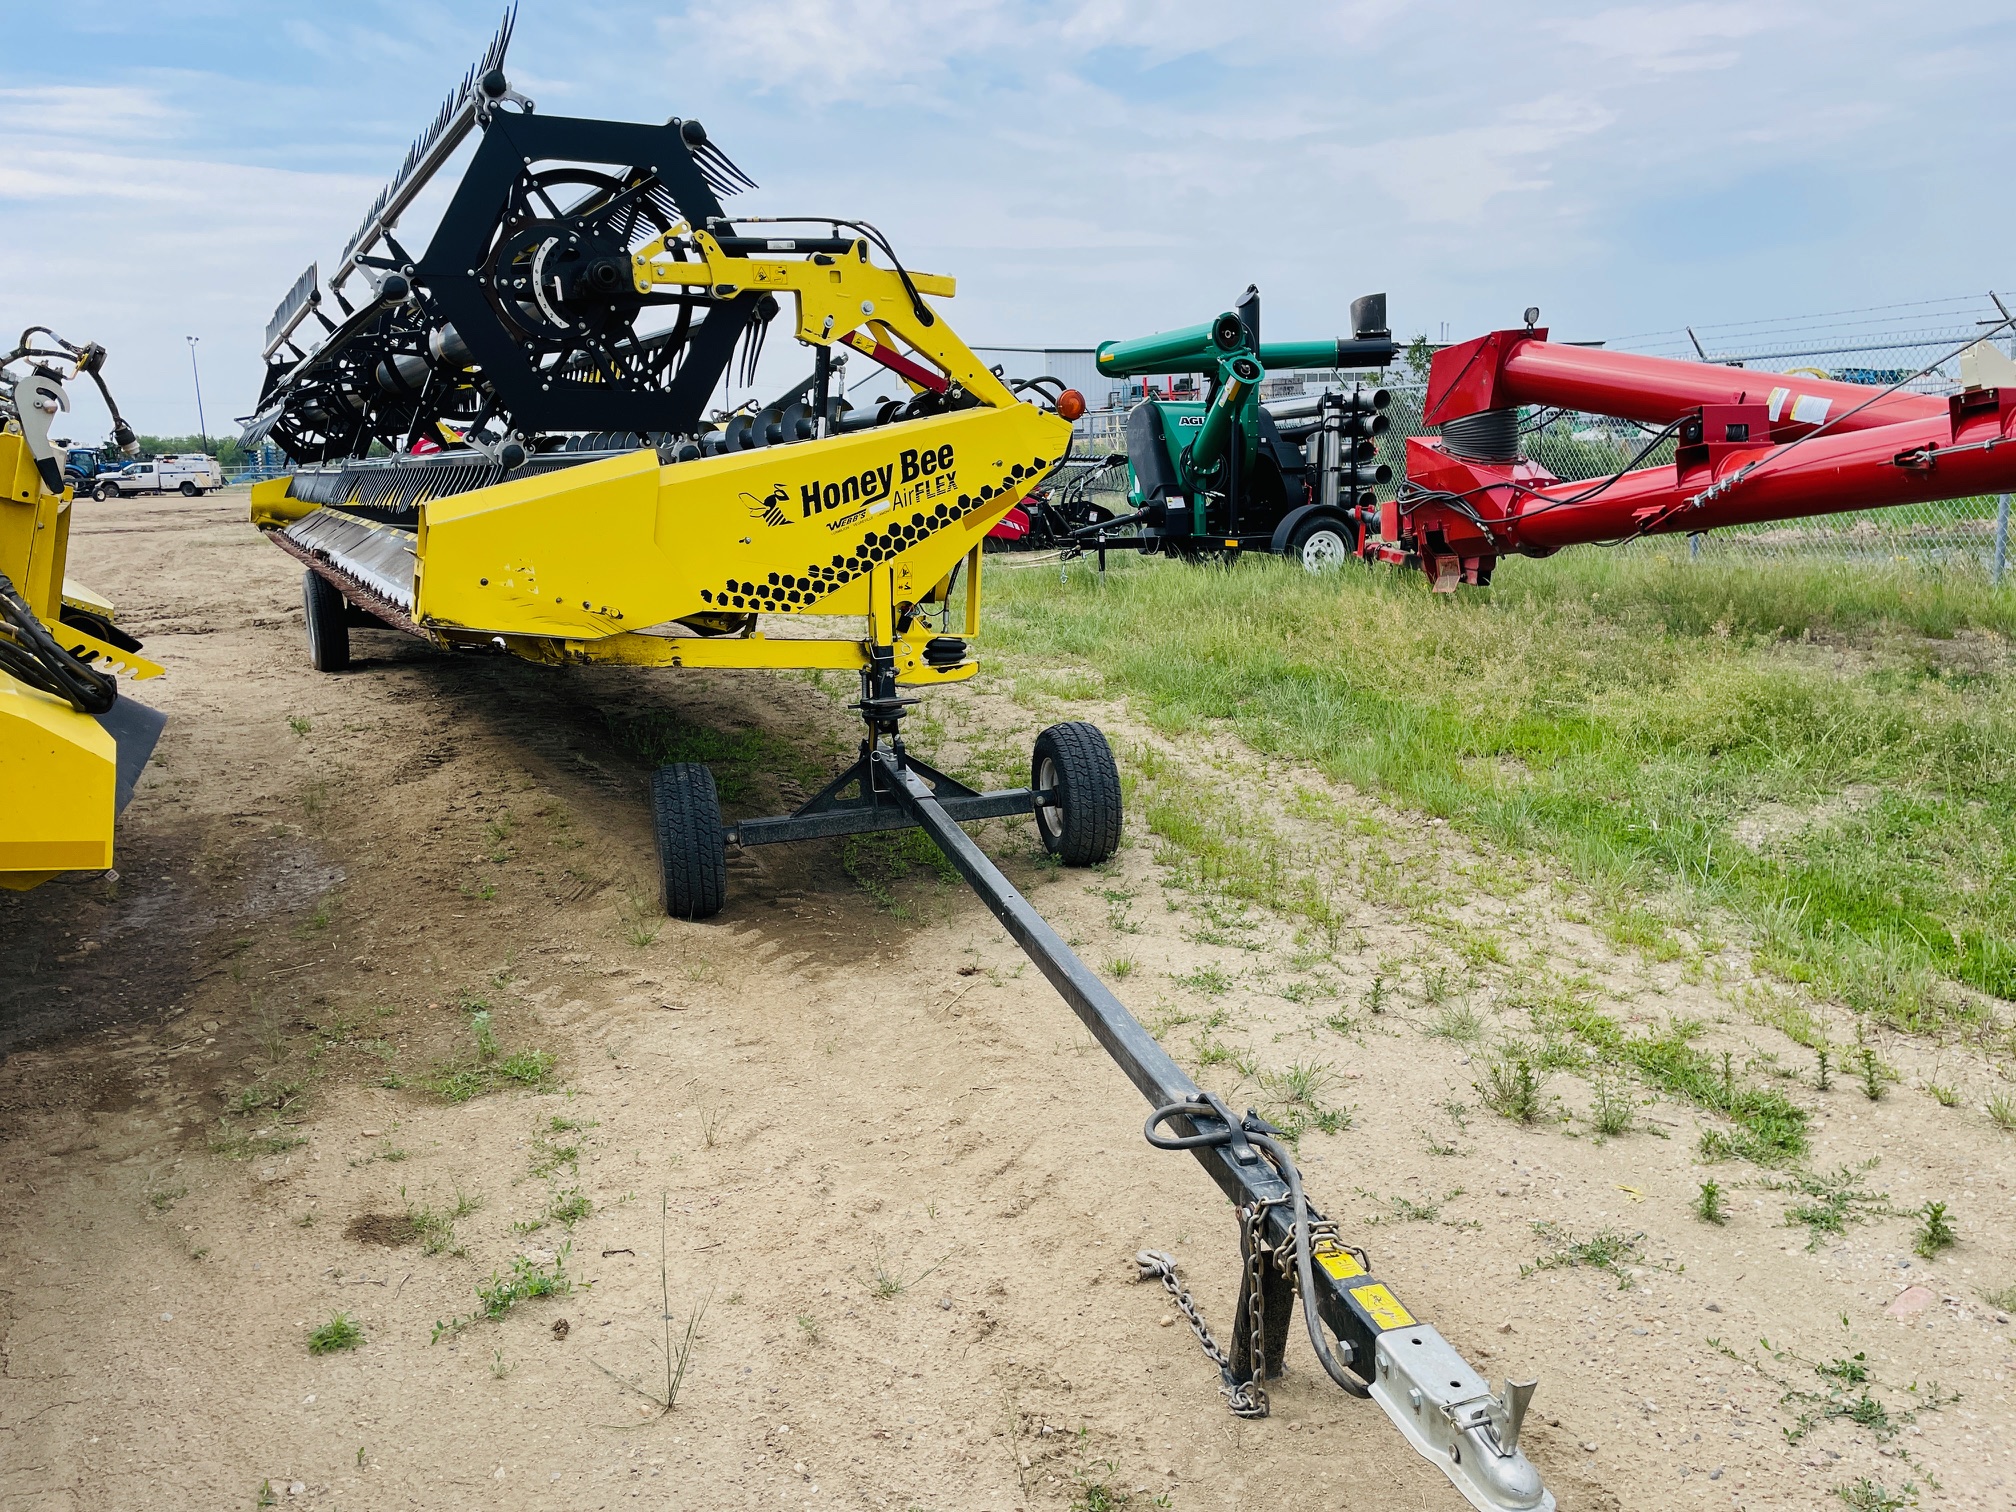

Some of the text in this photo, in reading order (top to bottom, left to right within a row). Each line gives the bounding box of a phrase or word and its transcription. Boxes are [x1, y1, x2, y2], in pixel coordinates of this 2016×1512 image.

[800, 444, 955, 518] Honey Bee
[892, 470, 959, 512] AirFLEX
